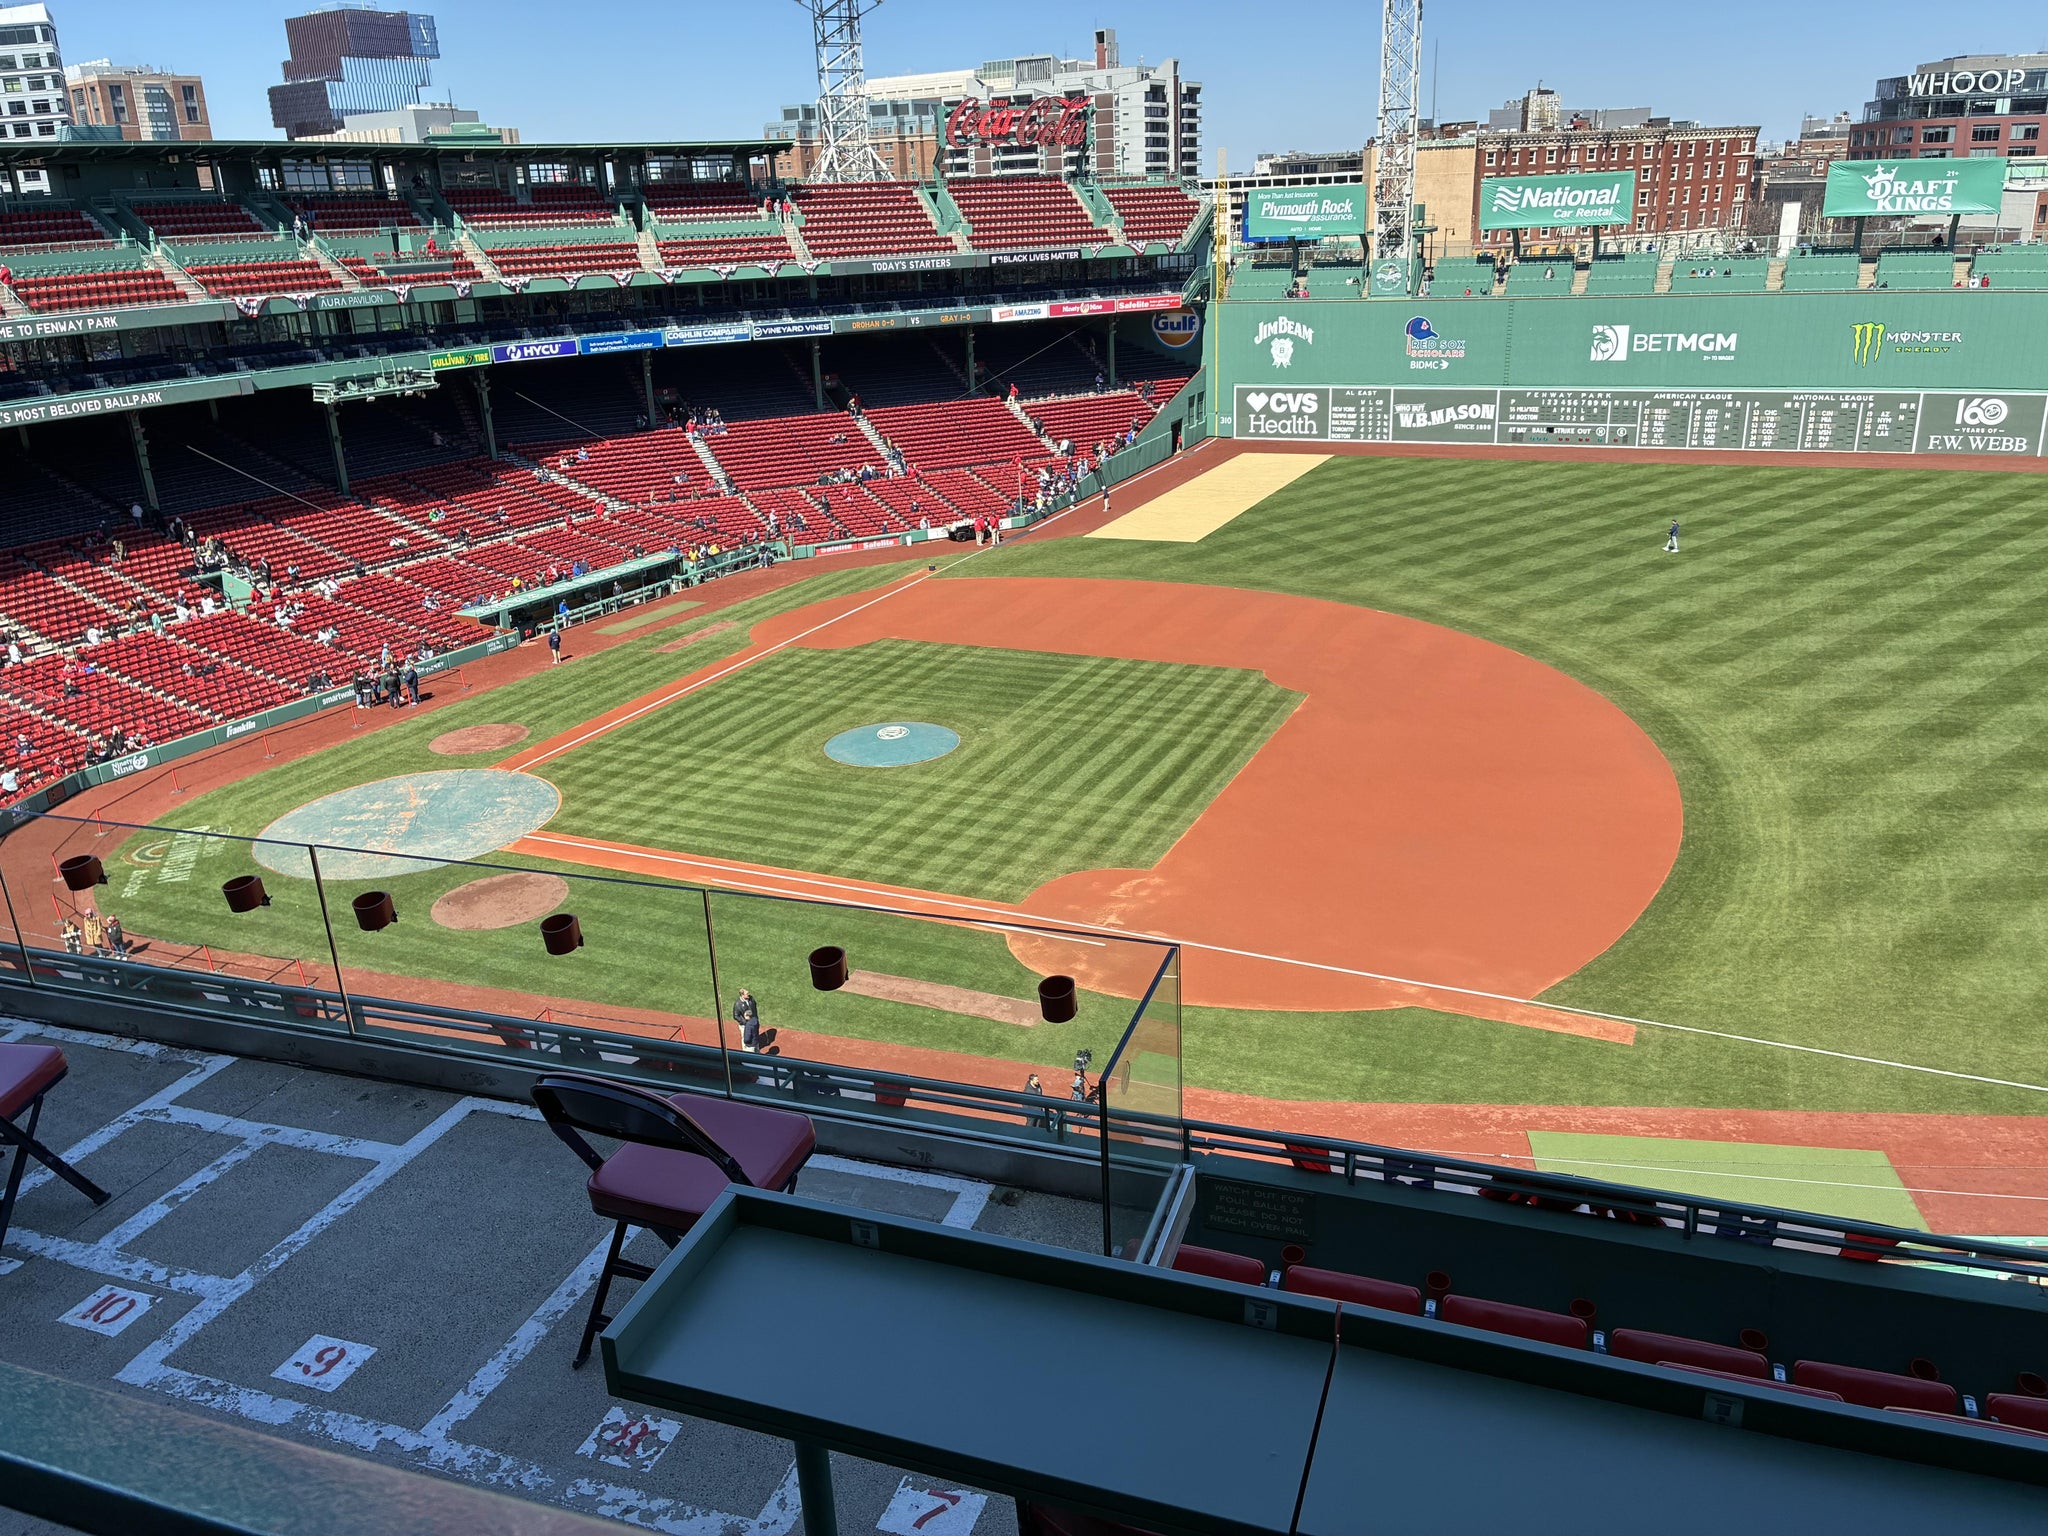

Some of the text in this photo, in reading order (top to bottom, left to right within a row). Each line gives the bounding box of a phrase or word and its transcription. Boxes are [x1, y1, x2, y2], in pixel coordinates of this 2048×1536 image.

[1907, 69, 2026, 97] WHOOP
[988, 99, 1009, 108] ENJOY
[1866, 179, 1958, 200] DRAFT
[1261, 199, 1354, 217] Plymouth Rock
[1875, 196, 1952, 211] KINGS
[1553, 206, 1613, 218] Car Rental
[1003, 252, 1079, 263] BLACK LIVES MATTER
[872, 258, 951, 272] TODAY'S STARTERS
[348, 294, 384, 305] PAVILION
[1119, 299, 1150, 310] Safelite
[1014, 308, 1041, 317] AMAZING
[1062, 305, 1080, 313] Ninety
[18, 324, 34, 336] TO
[36, 319, 84, 335] FENWAY
[88, 316, 119, 330] PARK
[762, 323, 830, 335] VINEYARD VINES
[852, 321, 880, 329] DROHAN
[882, 319, 895, 327] 0-0
[910, 317, 920, 325] VS
[940, 315, 959, 323] GRAY
[1153, 314, 1197, 332] Gulf
[668, 331, 702, 340] COGHLIN
[702, 327, 749, 338] COMPANIES
[1411, 340, 1466, 350] RED SOX
[1633, 332, 1738, 352] BETMGM
[523, 344, 559, 357] HYCU
[1411, 349, 1465, 359] SCHOLARS
[432, 352, 489, 368] SULLIVAN TIRE
[1410, 360, 1439, 369] BIDMC
[14, 406, 46, 422] MOST
[50, 399, 102, 417] BELOVED
[104, 391, 163, 410] BALLPARK
[1269, 392, 1319, 414] CVS
[1394, 403, 1425, 413] WHO BUT
[1516, 413, 1539, 421] BOSTON
[1955, 397, 2009, 426] 160
[1219, 416, 1232, 425] 310
[1248, 414, 1319, 435] Health
[1454, 423, 1475, 431] SINCE
[1532, 427, 1548, 435] BALL
[1553, 427, 1576, 435] STRIKE
[1968, 436, 2028, 453] WEBB
[820, 543, 852, 553] Safelite
[863, 540, 895, 549] Safelite
[322, 688, 356, 706] smartwate
[226, 720, 256, 738] Franklin
[111, 758, 133, 770] Ninety
[113, 764, 134, 776] Nine
[1214, 1184, 1305, 1203] WATCH OUT FOR
[1219, 1195, 1248, 1206] FOUL
[1253, 1201, 1286, 1212] BALLS
[1215, 1205, 1303, 1225] PLEASE DO NOT
[1209, 1214, 1309, 1237] REACH OVER RAIL
[81, 1291, 137, 1325] 10
[302, 1345, 347, 1377] 9
[912, 1489, 961, 1530] 7
